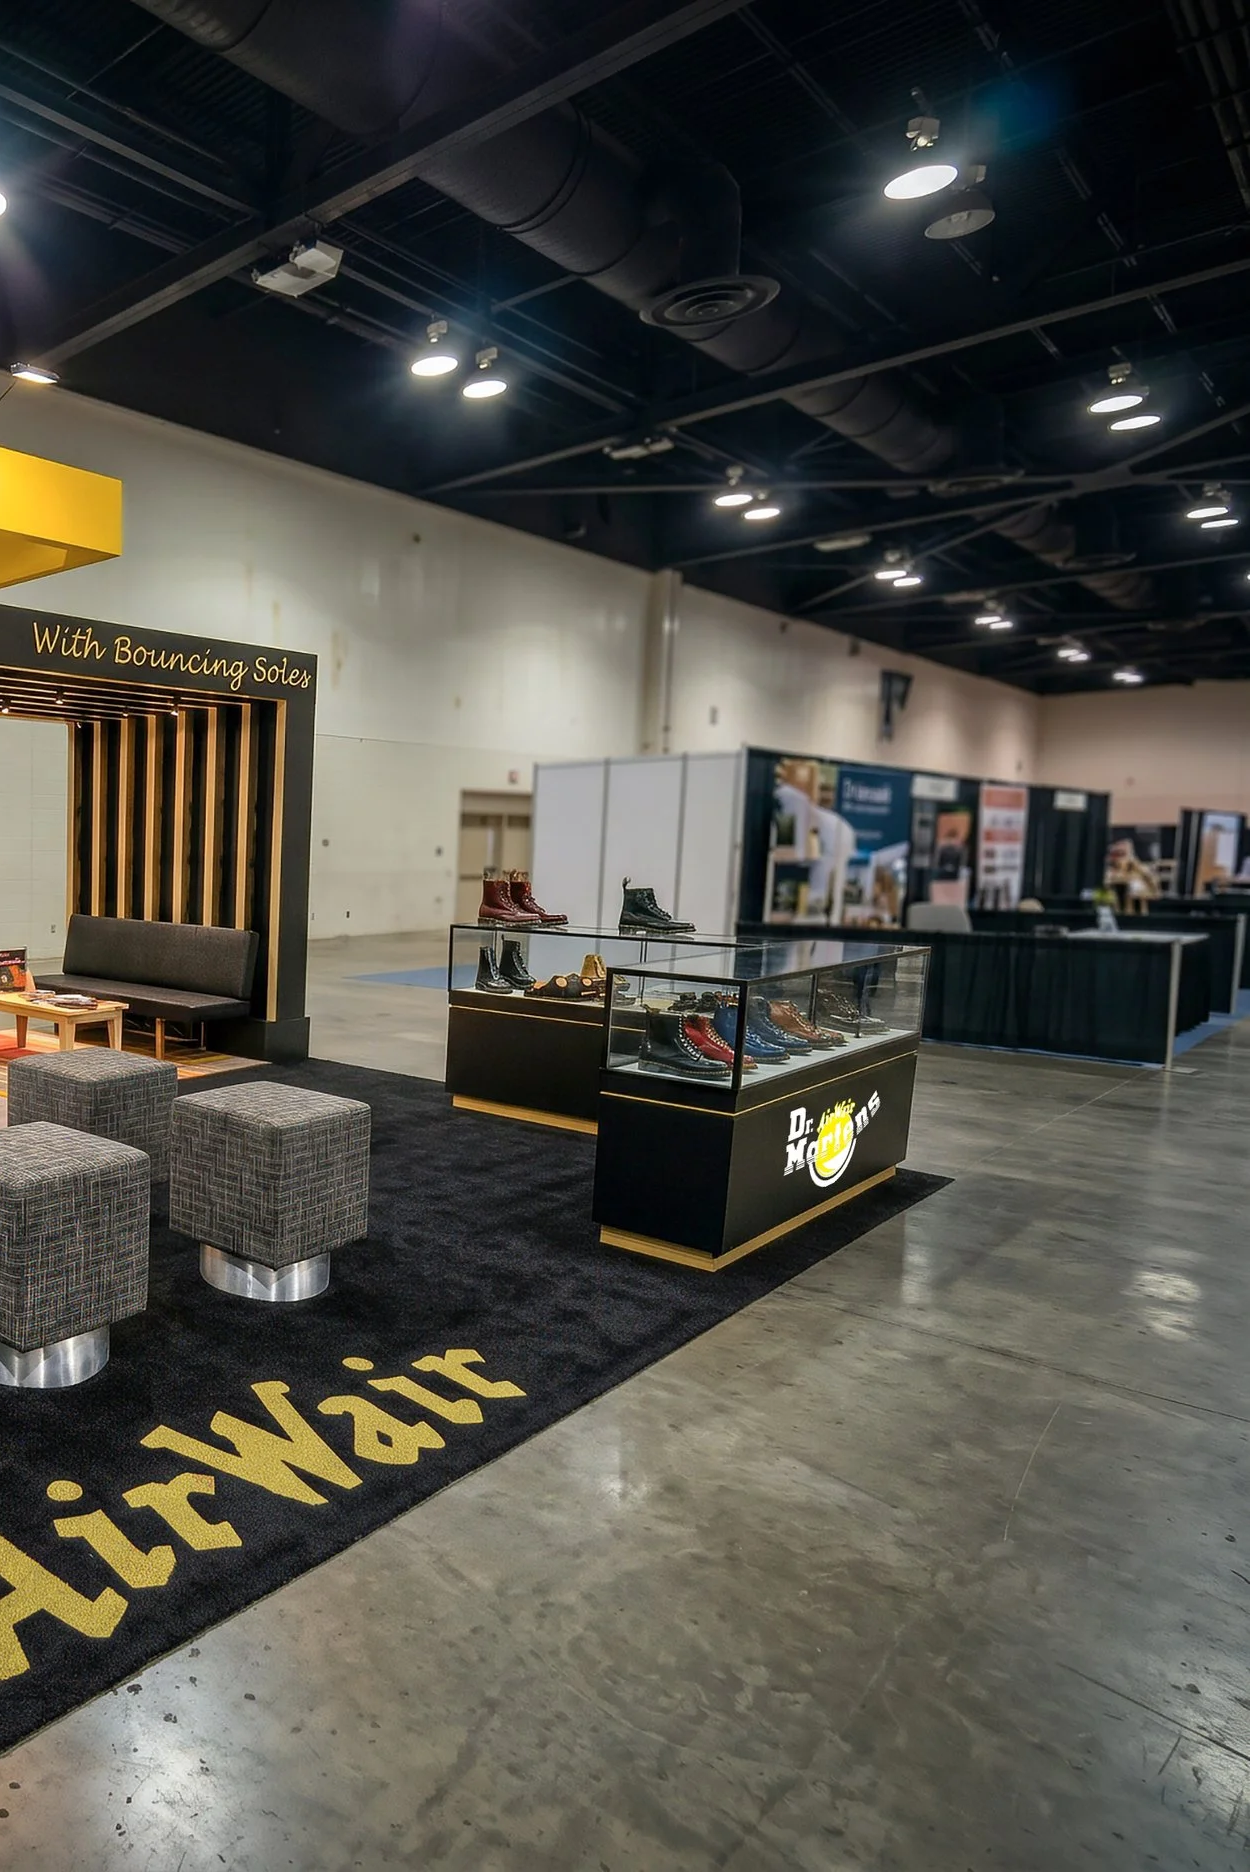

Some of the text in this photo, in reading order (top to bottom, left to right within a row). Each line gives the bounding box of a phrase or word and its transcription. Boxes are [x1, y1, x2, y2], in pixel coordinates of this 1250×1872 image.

[32, 621, 312, 691] With Bouncing Soles
[783, 1090, 881, 1177] Martens
[788, 1106, 814, 1142] Dr.
